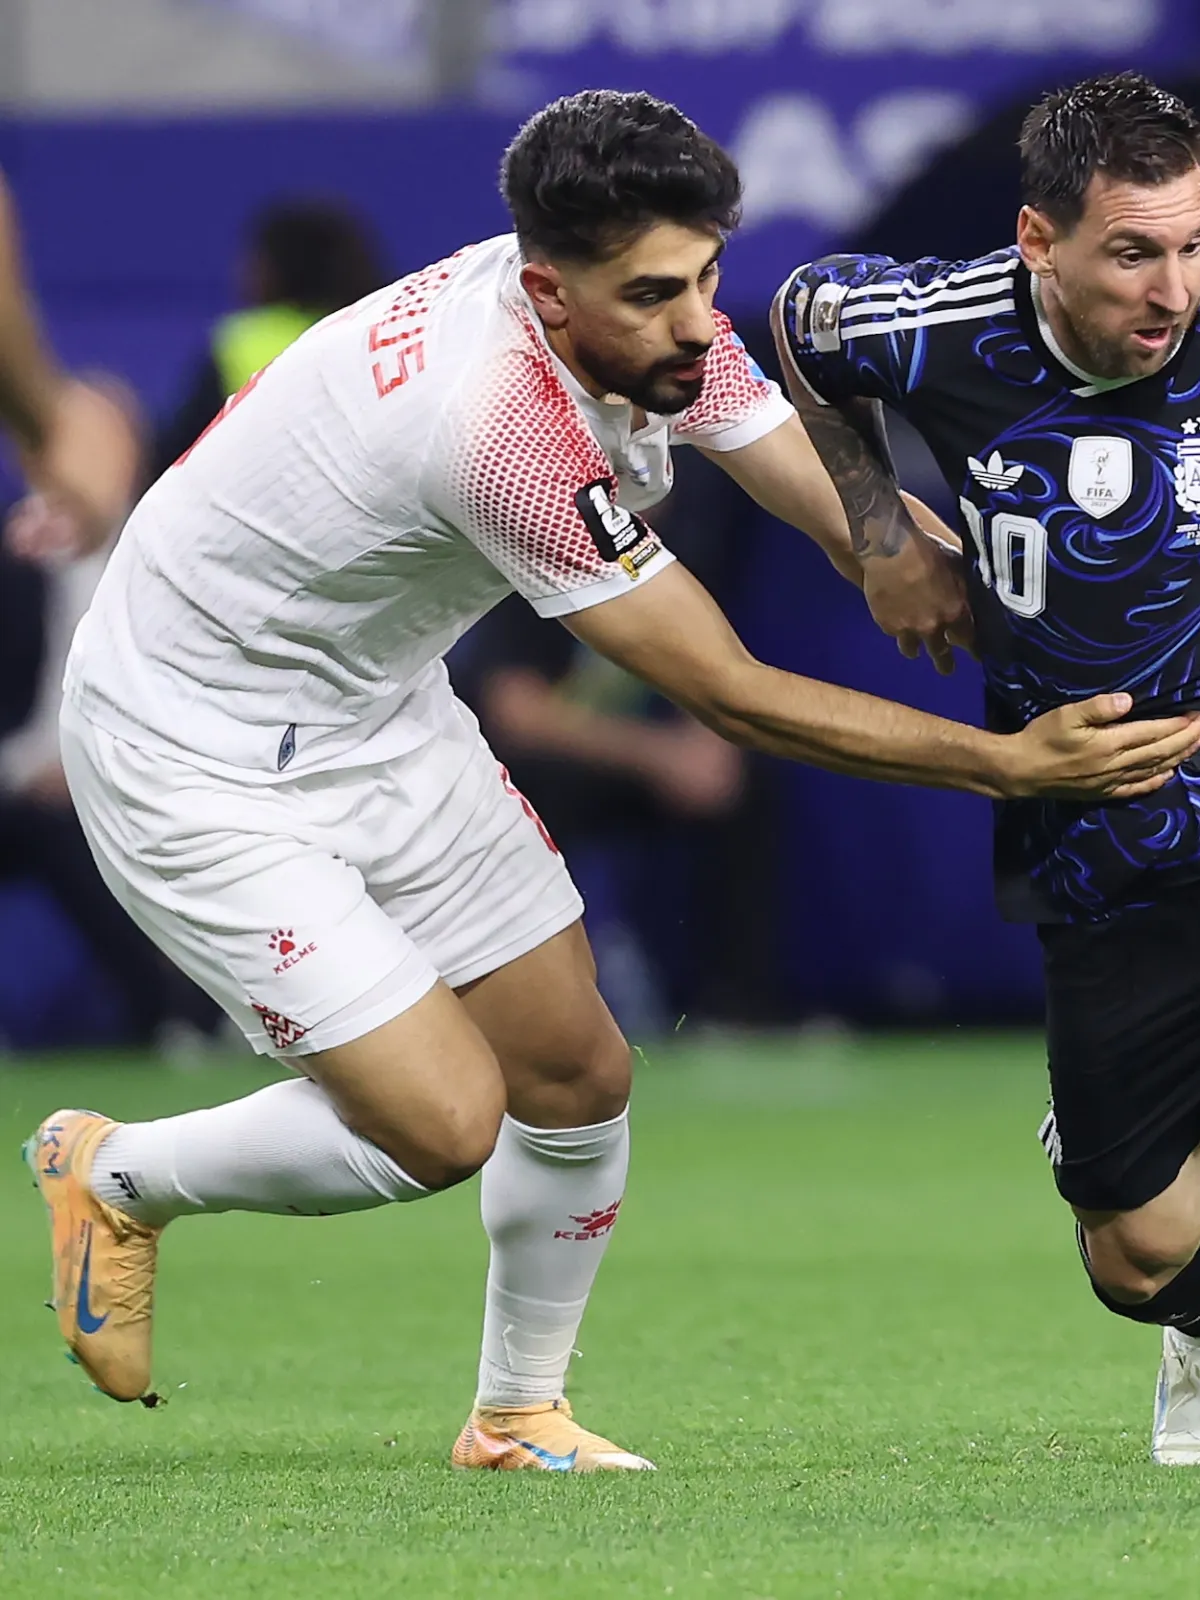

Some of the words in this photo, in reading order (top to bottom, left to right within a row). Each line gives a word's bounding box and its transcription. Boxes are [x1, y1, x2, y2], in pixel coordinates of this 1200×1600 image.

[1086, 487, 1113, 498] FIFA
[273, 941, 318, 975] KELME
[553, 1219, 617, 1241] KEL
